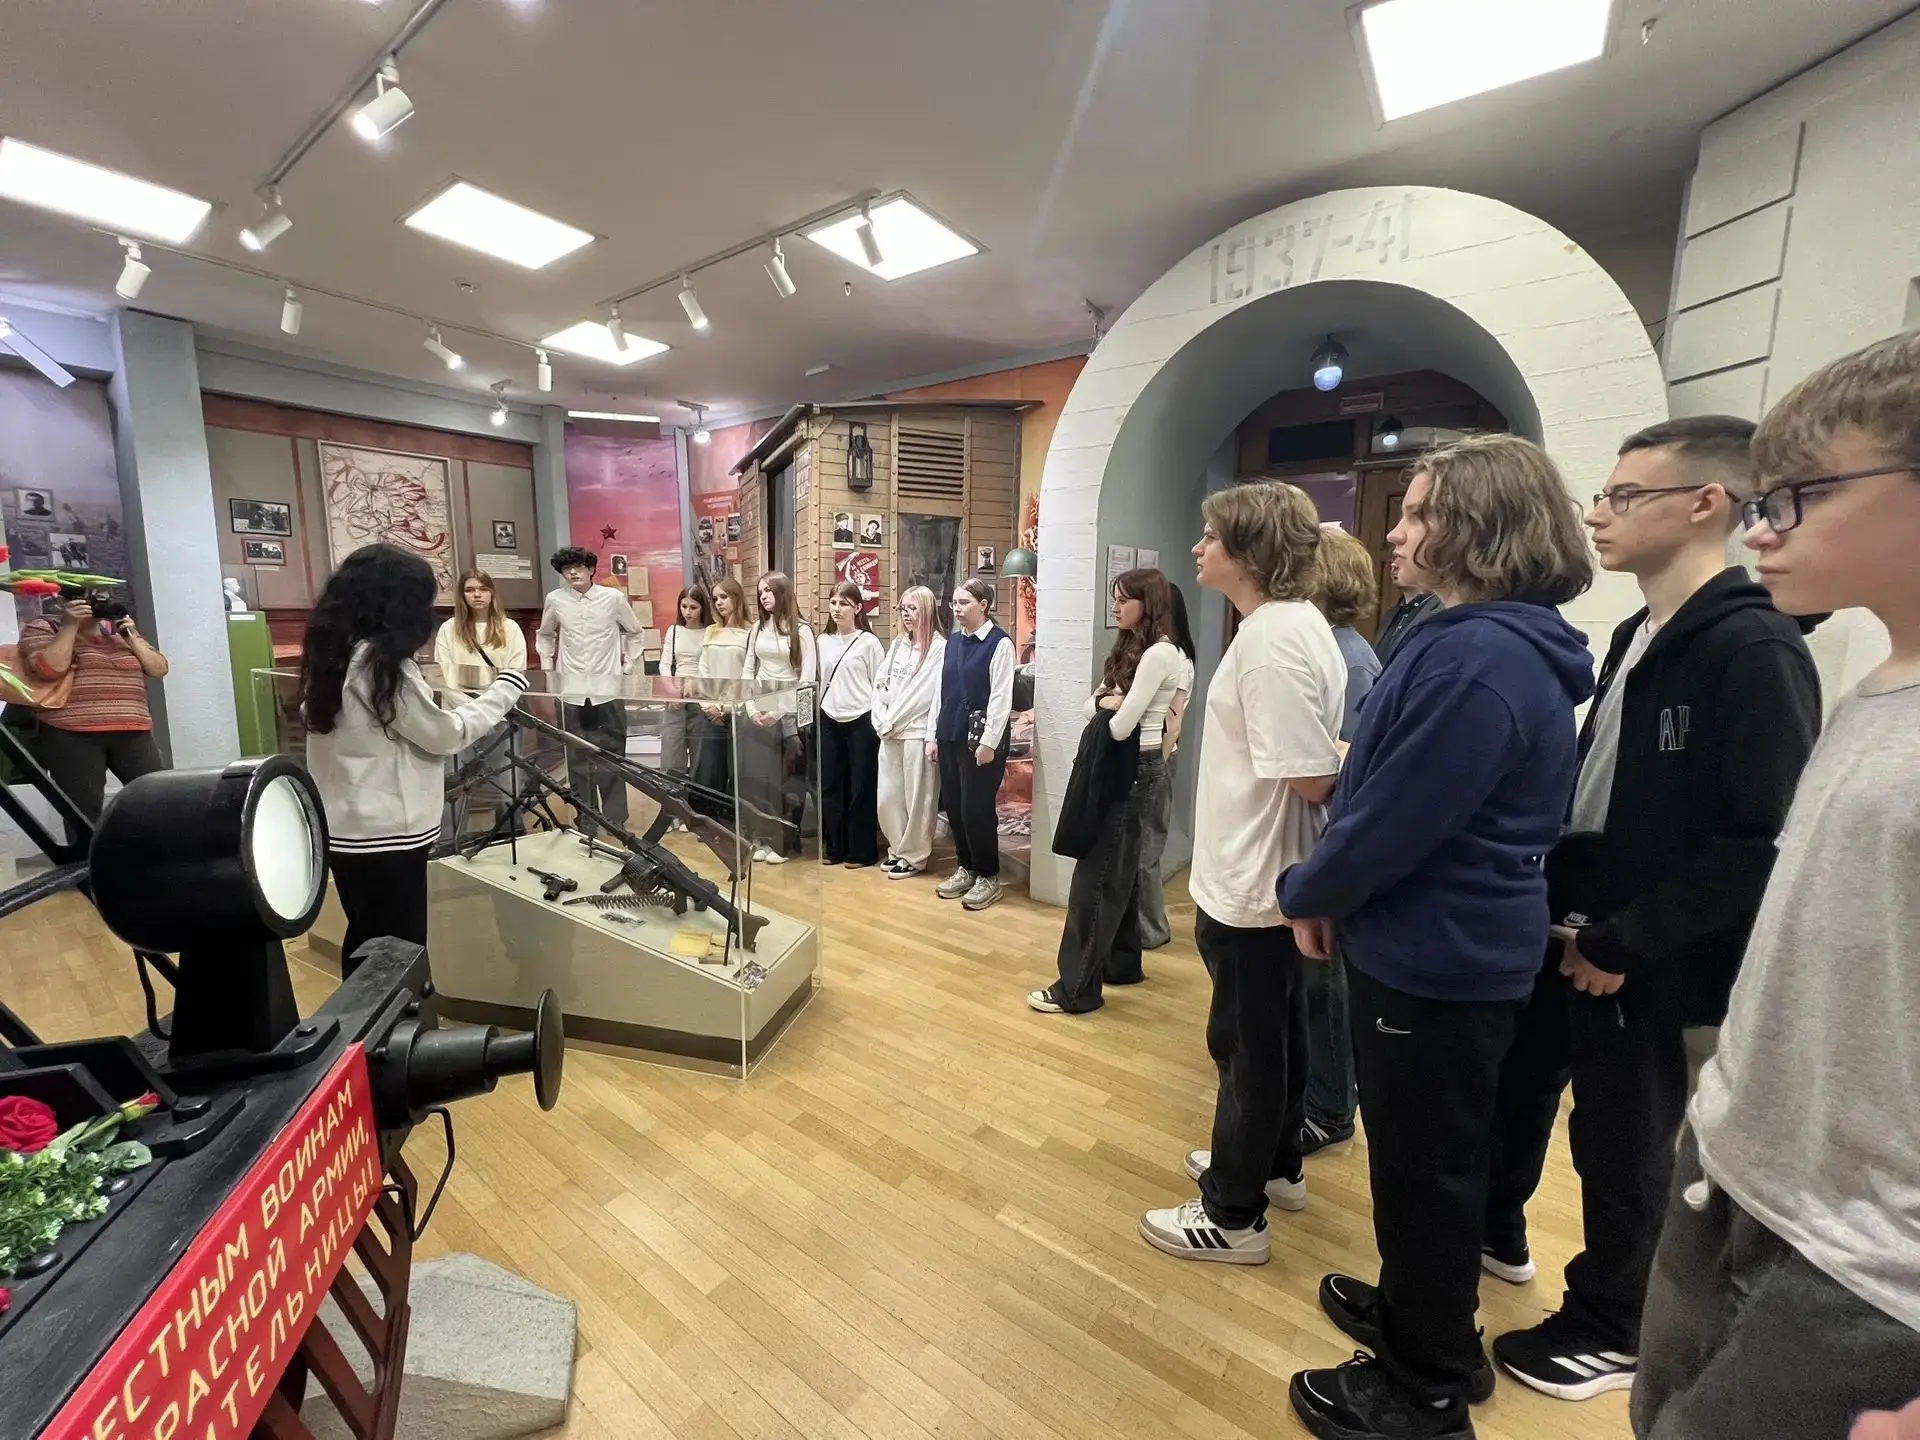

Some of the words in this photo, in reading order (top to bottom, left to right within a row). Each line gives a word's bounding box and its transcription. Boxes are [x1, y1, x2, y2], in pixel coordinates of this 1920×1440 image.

[1209, 192, 1415, 304] 1937-41
[81, 1221, 250, 1440] ЕСТНЫМ
[260, 1077, 354, 1231] ВОИНАМ
[116, 1236, 287, 1440] РАСНОЙ
[299, 1115, 371, 1246] АРМИИ,
[206, 1156, 375, 1440] ТЕЛЬНИЦЫ!
